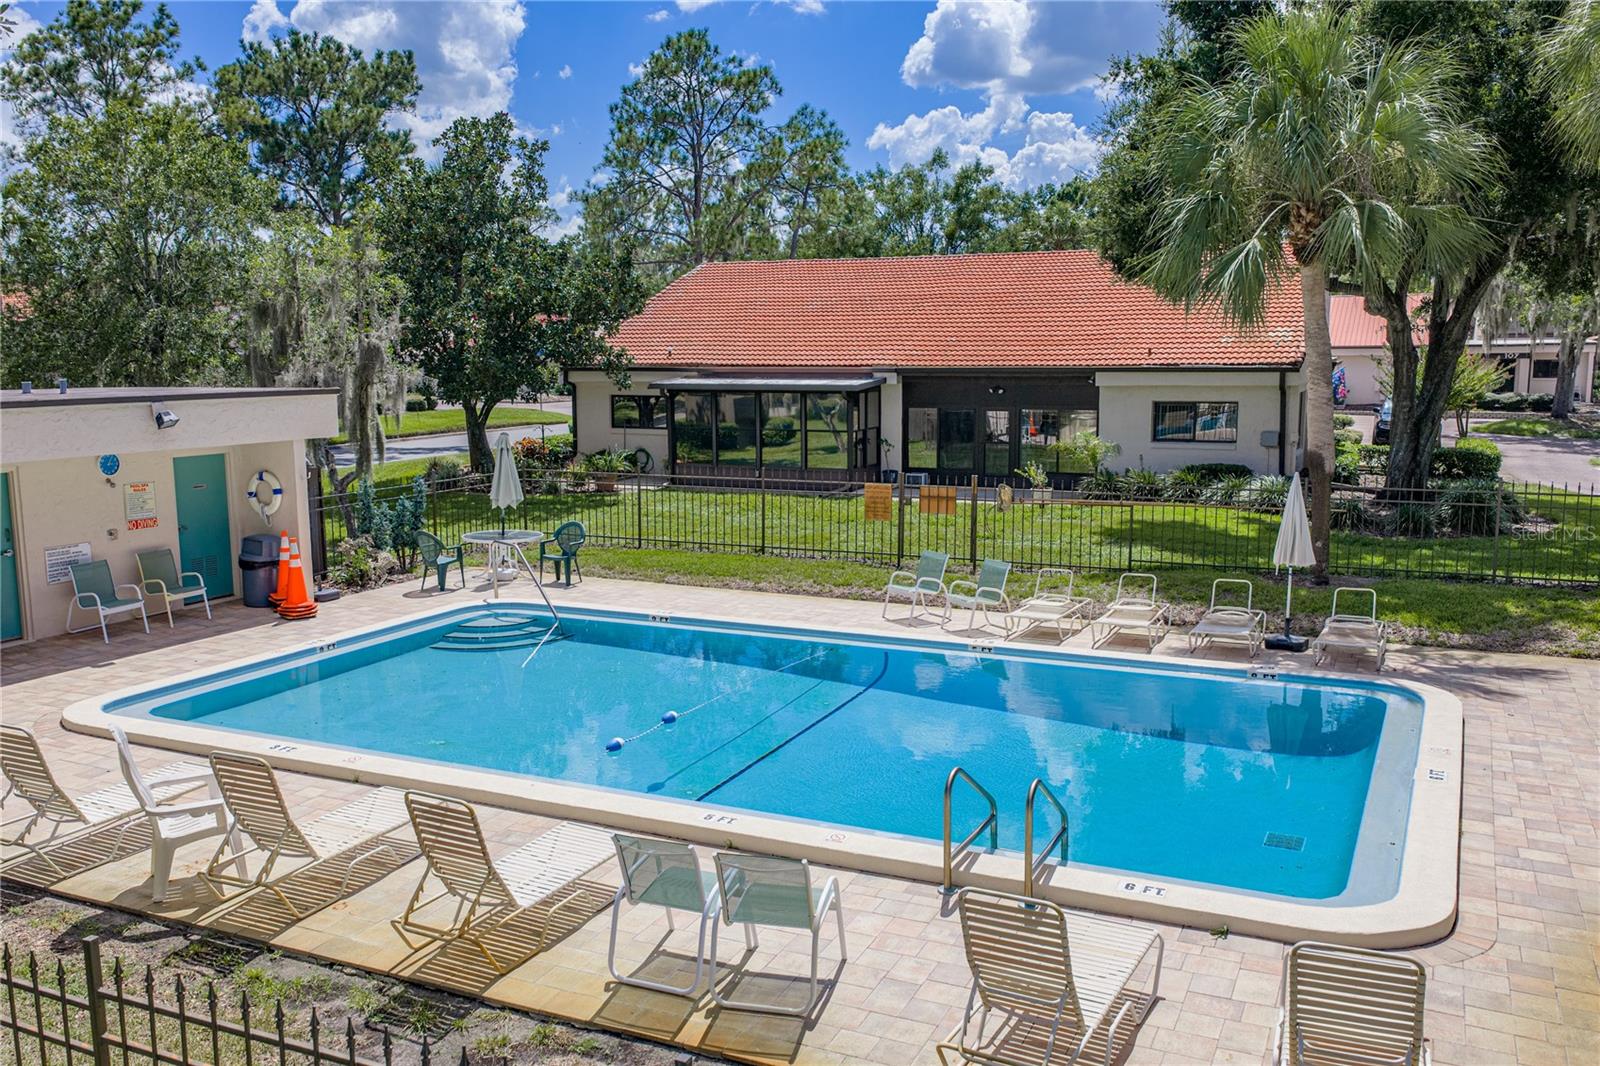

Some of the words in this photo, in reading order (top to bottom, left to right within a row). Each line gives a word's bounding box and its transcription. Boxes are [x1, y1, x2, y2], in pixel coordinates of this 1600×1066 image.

[128, 520, 137, 531] NO
[138, 517, 159, 530] DIVING
[1124, 882, 1137, 891] 6
